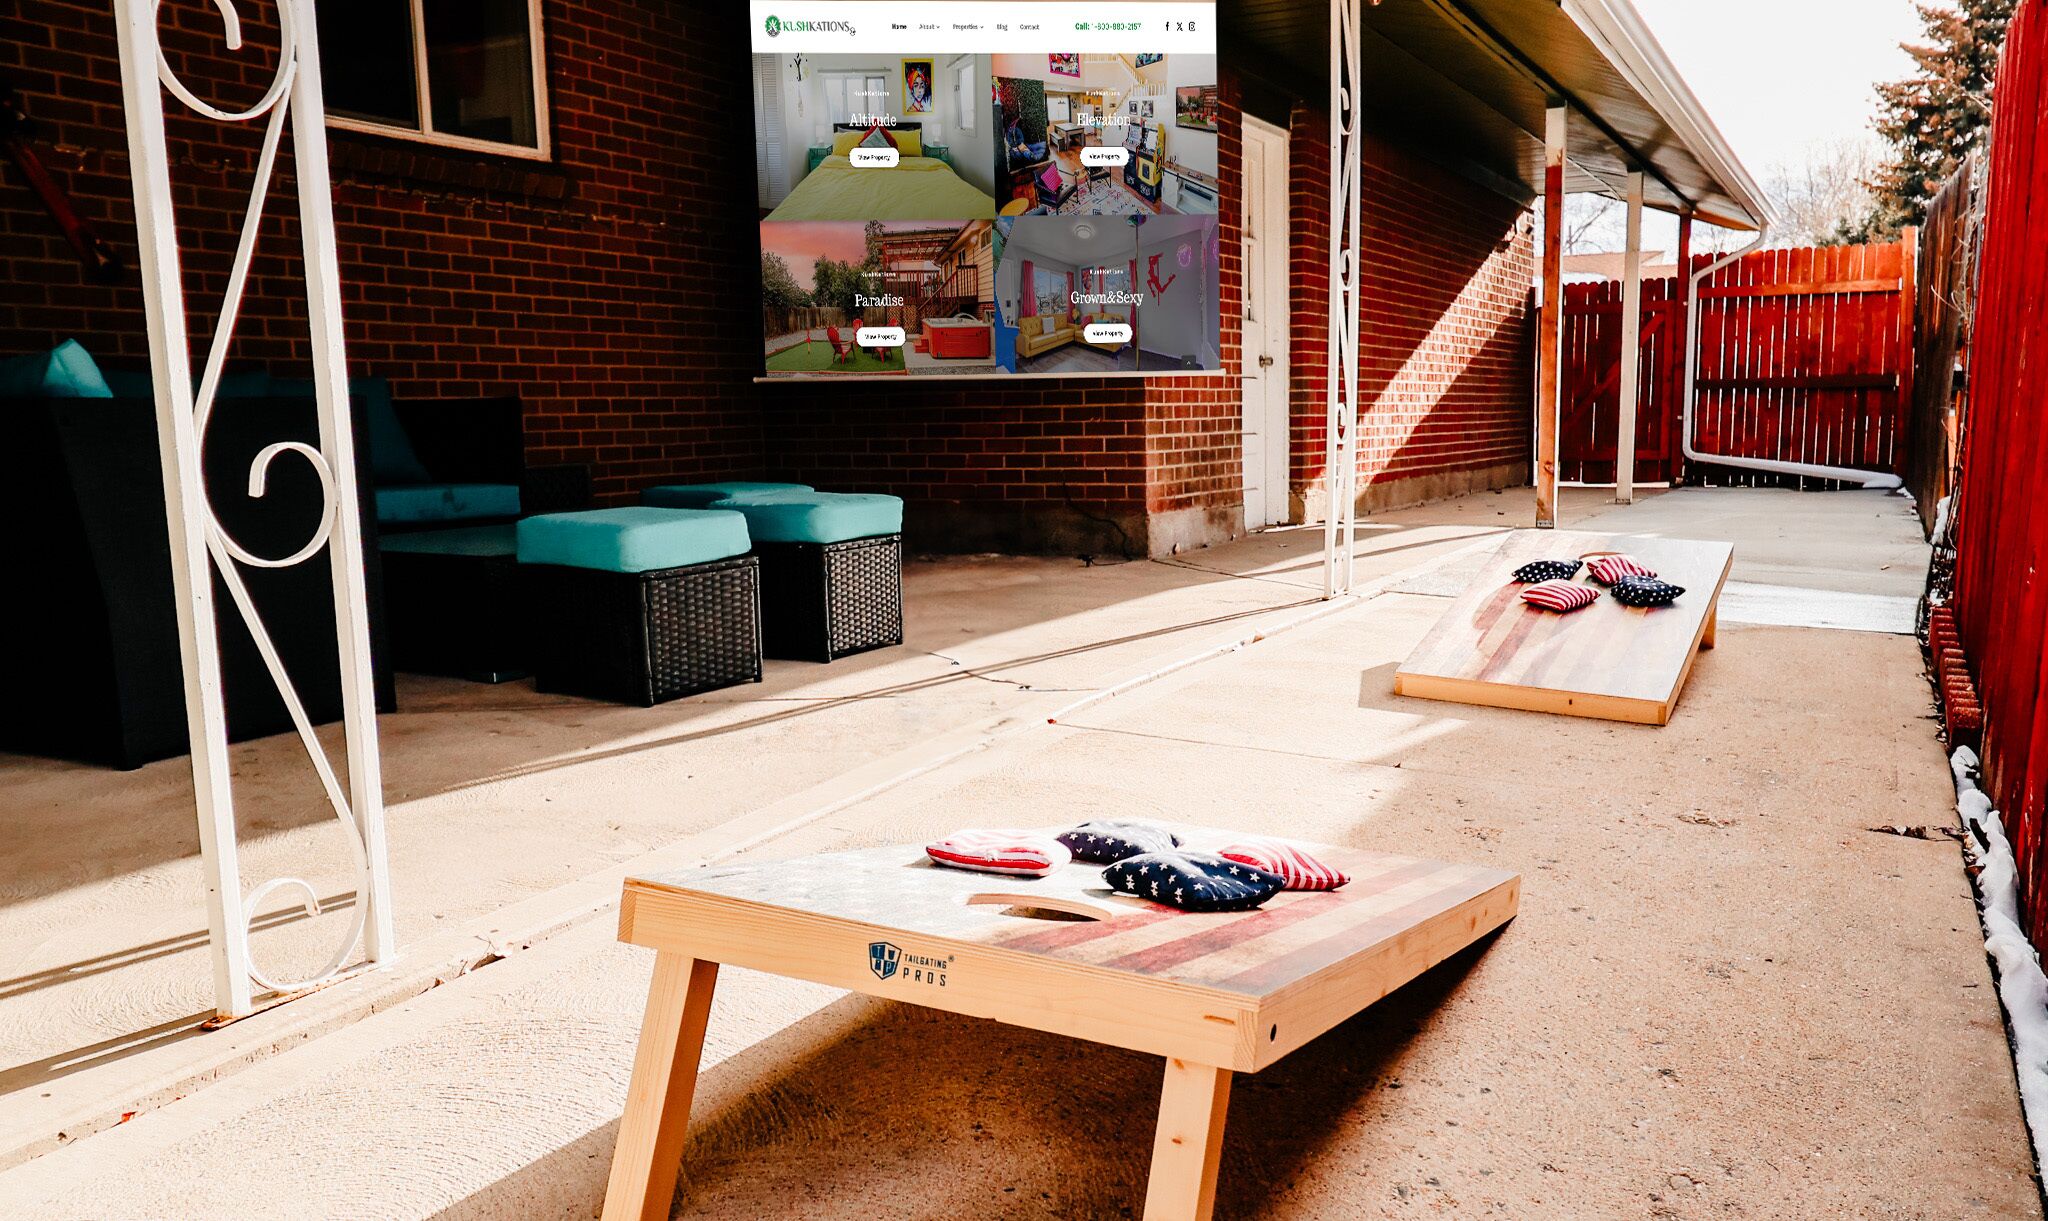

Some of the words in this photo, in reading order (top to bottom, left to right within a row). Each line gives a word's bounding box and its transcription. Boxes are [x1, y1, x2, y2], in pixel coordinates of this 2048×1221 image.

[783, 21, 850, 32] KUSHKATIONS
[952, 23, 979, 31] Properties
[1075, 22, 1090, 30] Call:
[1091, 22, 1142, 30] -800-880-2157
[849, 113, 897, 127] Altitude
[1077, 112, 1131, 126] Elevation
[871, 154, 891, 162] Property
[854, 293, 904, 307] Paradise
[1070, 290, 1144, 306] Grown&Sexy
[904, 954, 947, 969] TAILGATING
[903, 967, 946, 987] PROS
